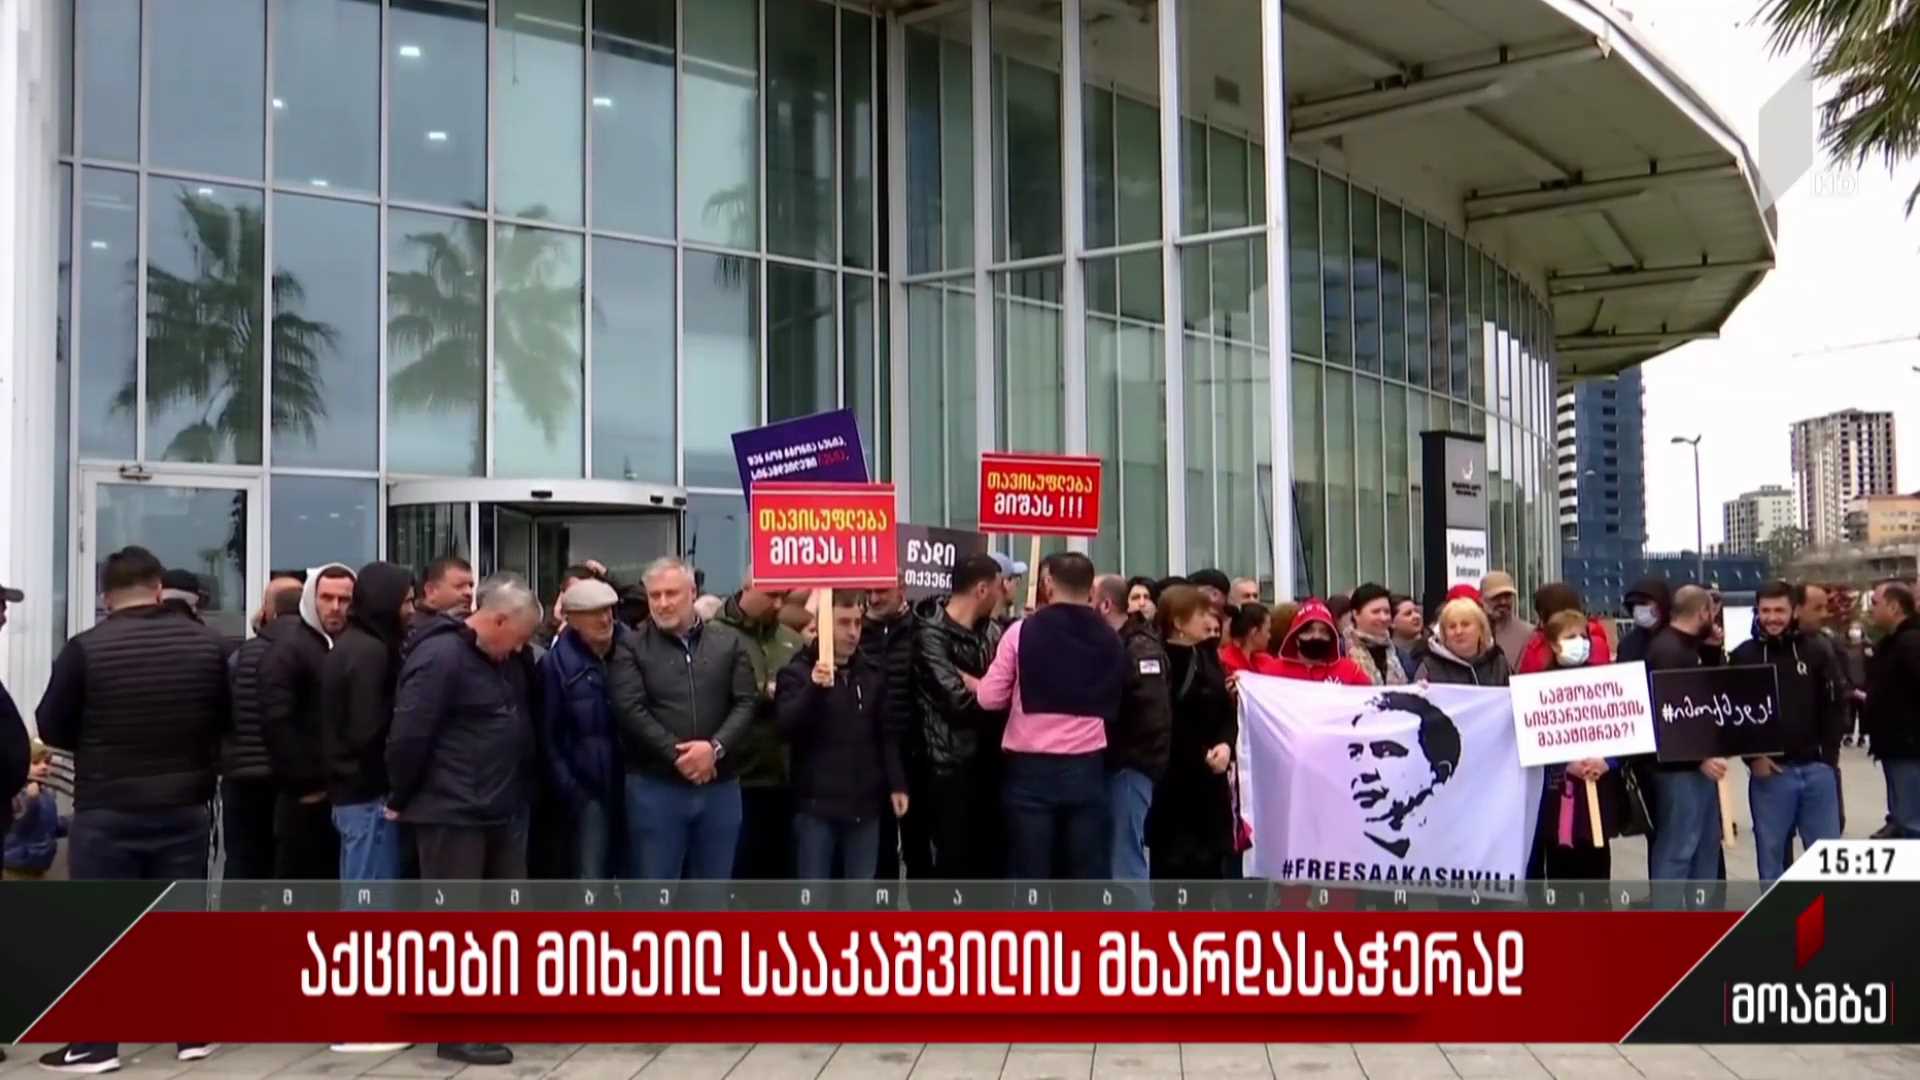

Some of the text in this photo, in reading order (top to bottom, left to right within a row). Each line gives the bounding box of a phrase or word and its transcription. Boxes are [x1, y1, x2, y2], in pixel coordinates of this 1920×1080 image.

[987, 472, 1093, 494] თავისუფლება
[994, 493, 1053, 518] მიშას
[759, 508, 887, 532] თავისუფლება
[770, 536, 843, 566] მიშას
[907, 539, 956, 567] წადი
[1538, 681, 1624, 705] სამშობლოს
[1523, 699, 1645, 728] სიყვარულისთვის
[1282, 857, 1516, 894] #FREESAAKASHVILI
